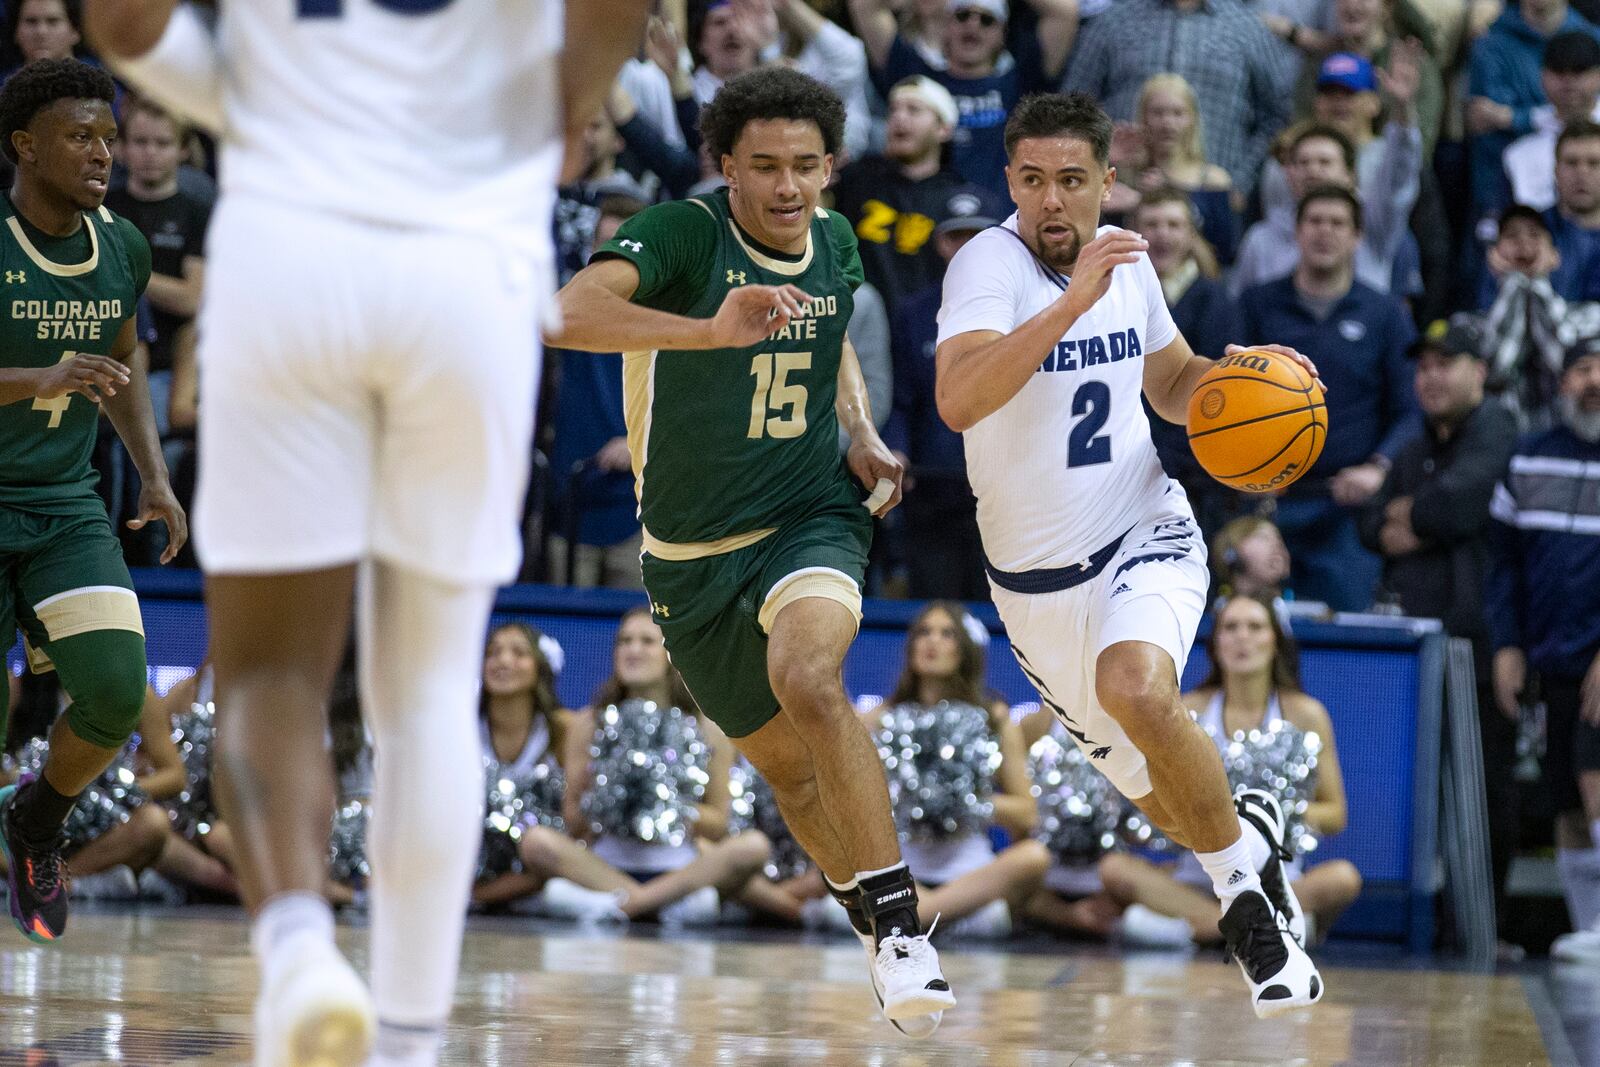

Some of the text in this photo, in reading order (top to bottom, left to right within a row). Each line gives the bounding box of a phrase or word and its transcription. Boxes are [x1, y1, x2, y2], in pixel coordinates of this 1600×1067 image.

[12, 299, 122, 320] COLORADO
[37, 321, 102, 340] STATE
[769, 319, 817, 341] ATE
[747, 351, 812, 439] 15
[1066, 380, 1113, 469] 2
